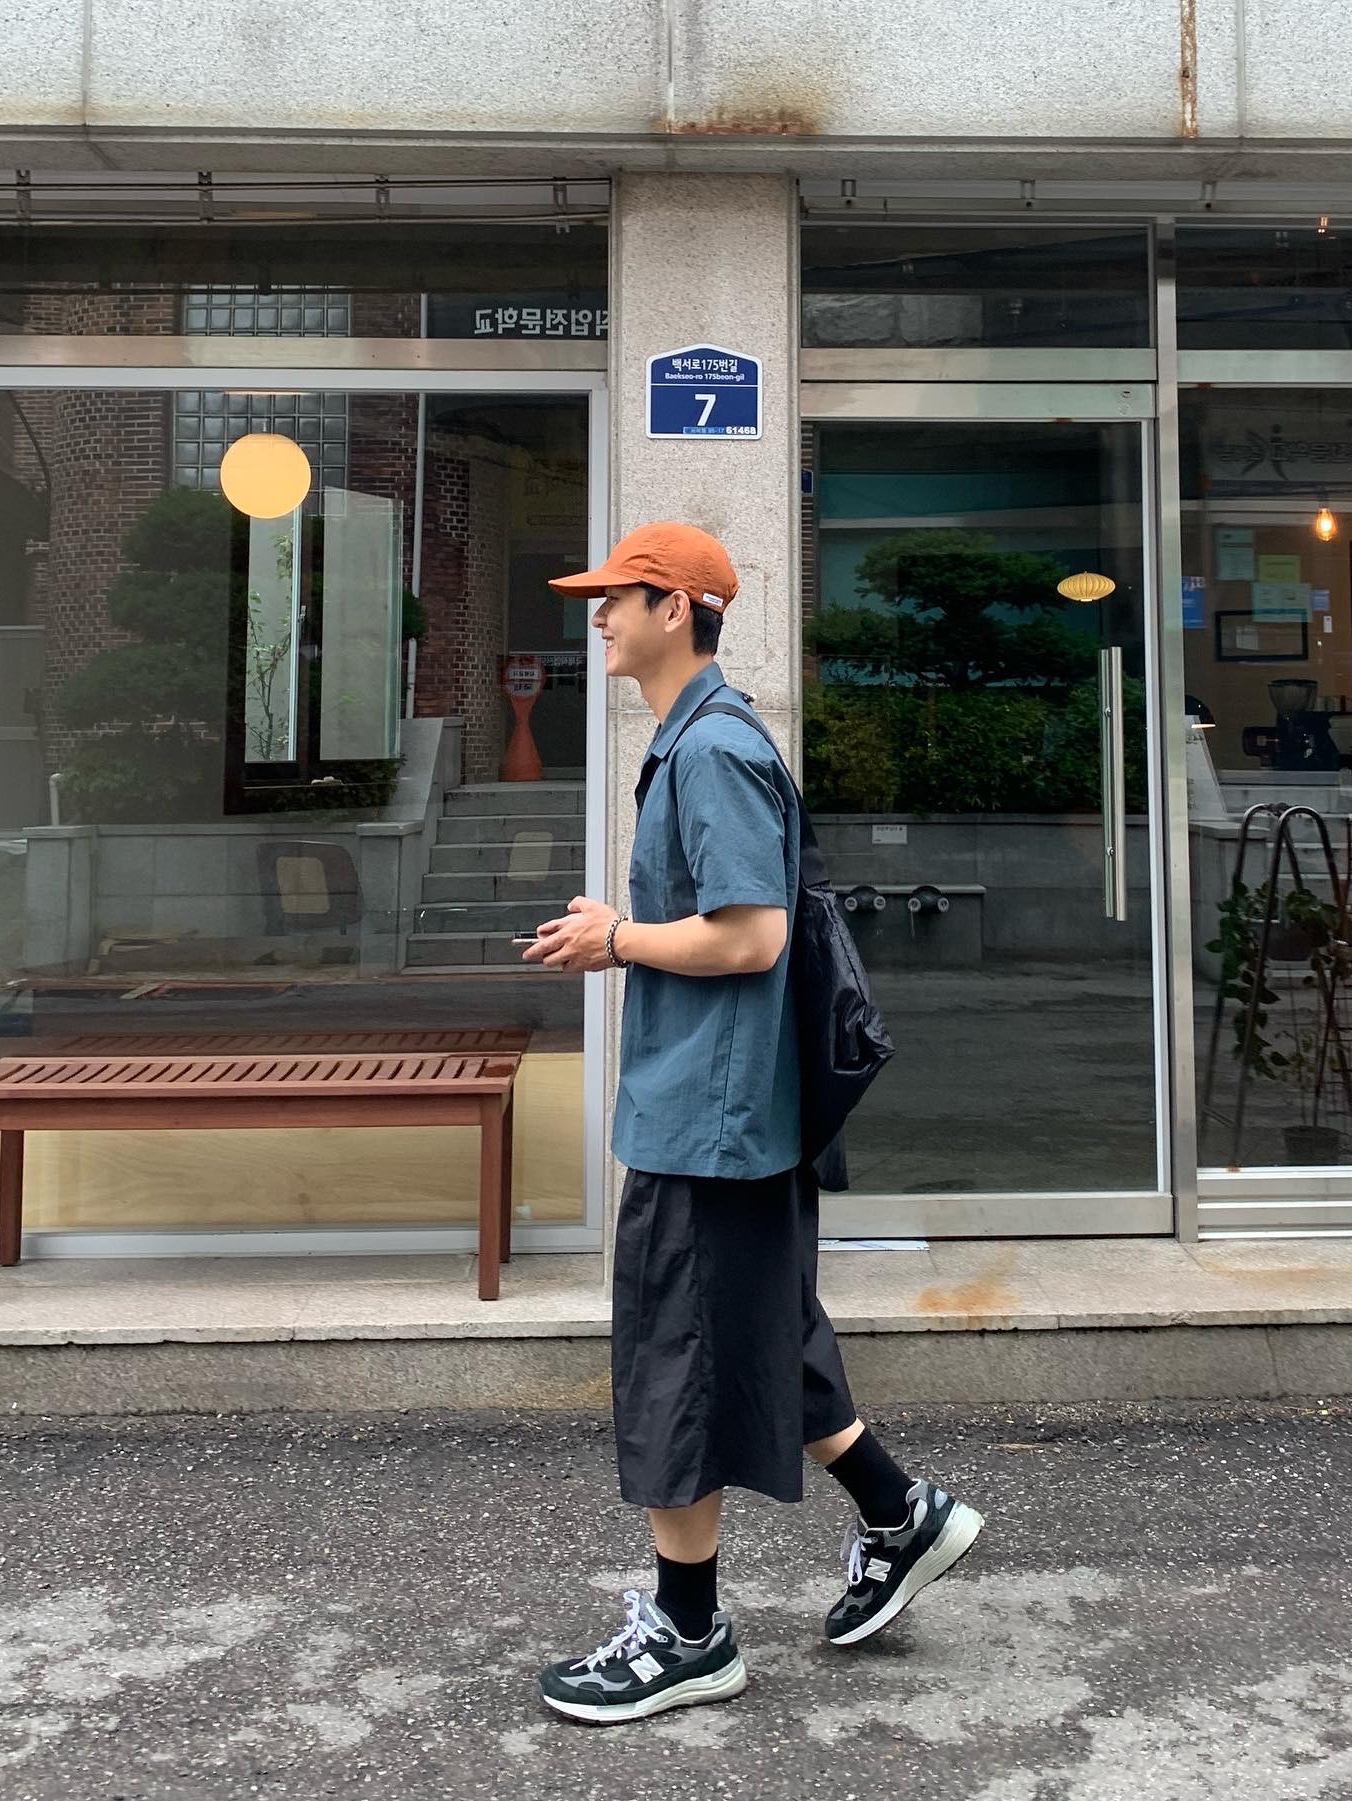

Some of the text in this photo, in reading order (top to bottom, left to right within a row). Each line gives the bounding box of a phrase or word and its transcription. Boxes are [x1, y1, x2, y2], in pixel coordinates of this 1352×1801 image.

[672, 358, 738, 372] 백서로175번길
[705, 373, 744, 382] 175beon-gil
[695, 394, 716, 427] 7
[726, 427, 756, 435] 61468
[864, 1557, 892, 1582] N
[628, 1652, 665, 1684] N
